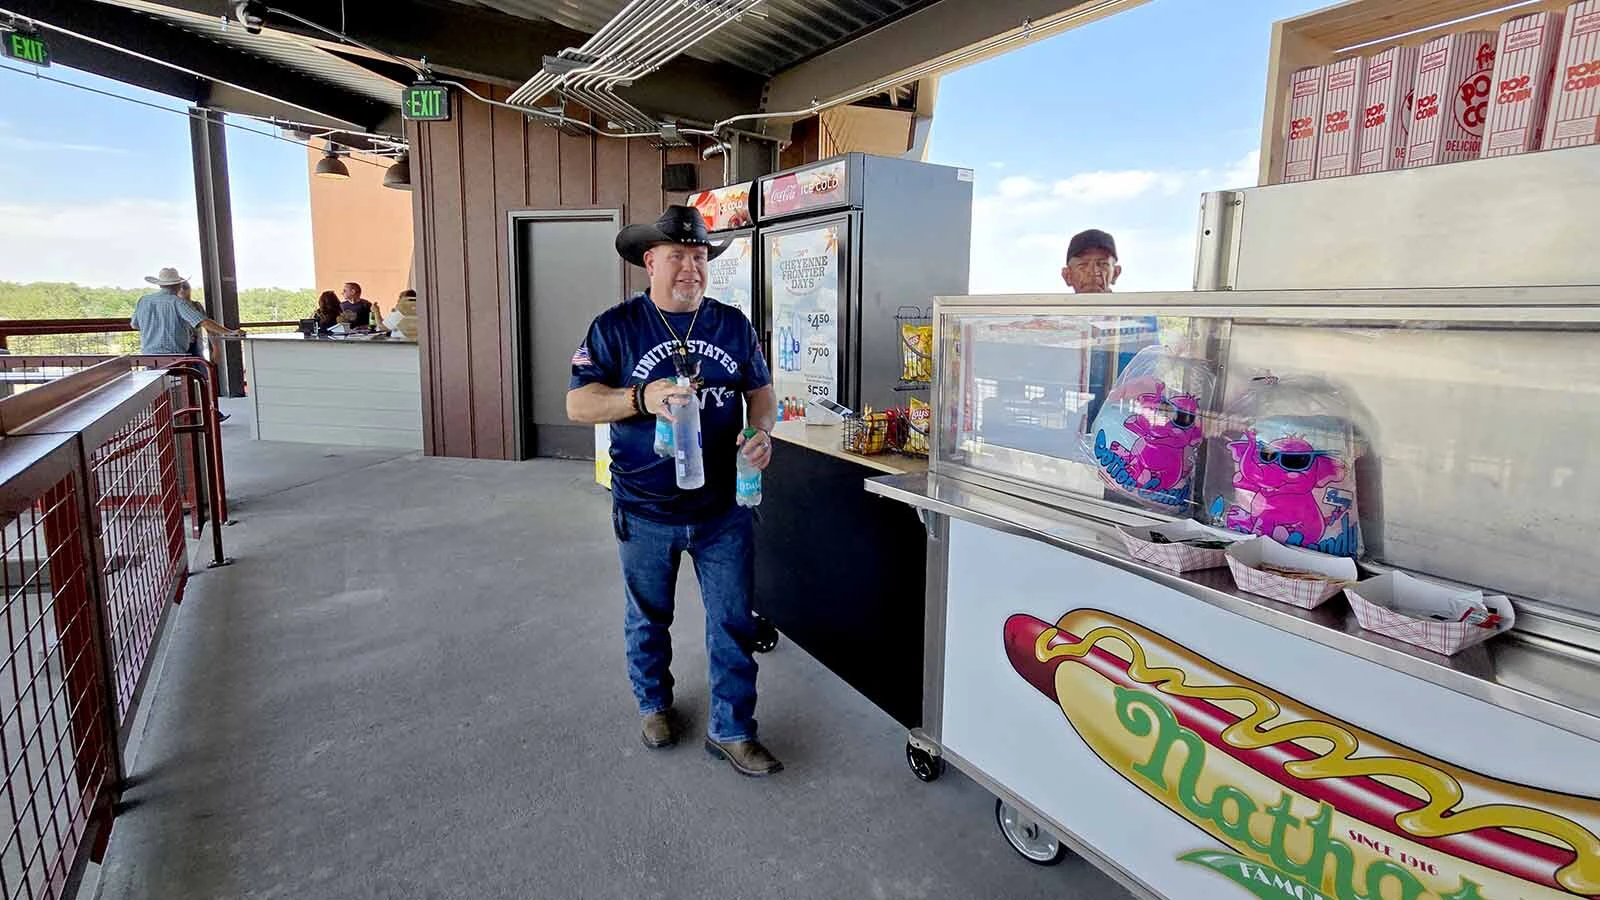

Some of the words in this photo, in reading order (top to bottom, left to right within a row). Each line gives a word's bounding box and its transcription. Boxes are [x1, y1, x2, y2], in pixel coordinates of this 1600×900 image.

[12, 34, 44, 63] EXIT
[1476, 43, 1496, 69] fre
[1461, 75, 1491, 107] PO
[1500, 75, 1530, 92] POP
[411, 90, 441, 116] EXIT
[1417, 93, 1437, 109] POP
[1498, 89, 1531, 104] CORN
[1327, 111, 1347, 124] POP
[1366, 103, 1385, 117] POP
[1416, 106, 1438, 120] CORN
[1464, 101, 1488, 127] CO
[1292, 117, 1312, 130] POP
[1325, 120, 1349, 134] CORN
[1365, 113, 1386, 129] CORN
[1290, 128, 1313, 140] CORN
[1446, 139, 1480, 152] DELICIO
[800, 184, 814, 195] ICE
[815, 177, 839, 192] COLD
[780, 256, 828, 272] CHEYENNE
[783, 267, 824, 280] FRONTIER
[791, 279, 815, 289] DAYS
[687, 340, 738, 374] STATES
[700, 387, 726, 409] VY
[1114, 686, 1485, 900] Natha
[1349, 830, 1393, 857] SINCE
[1400, 852, 1438, 876] 1916
